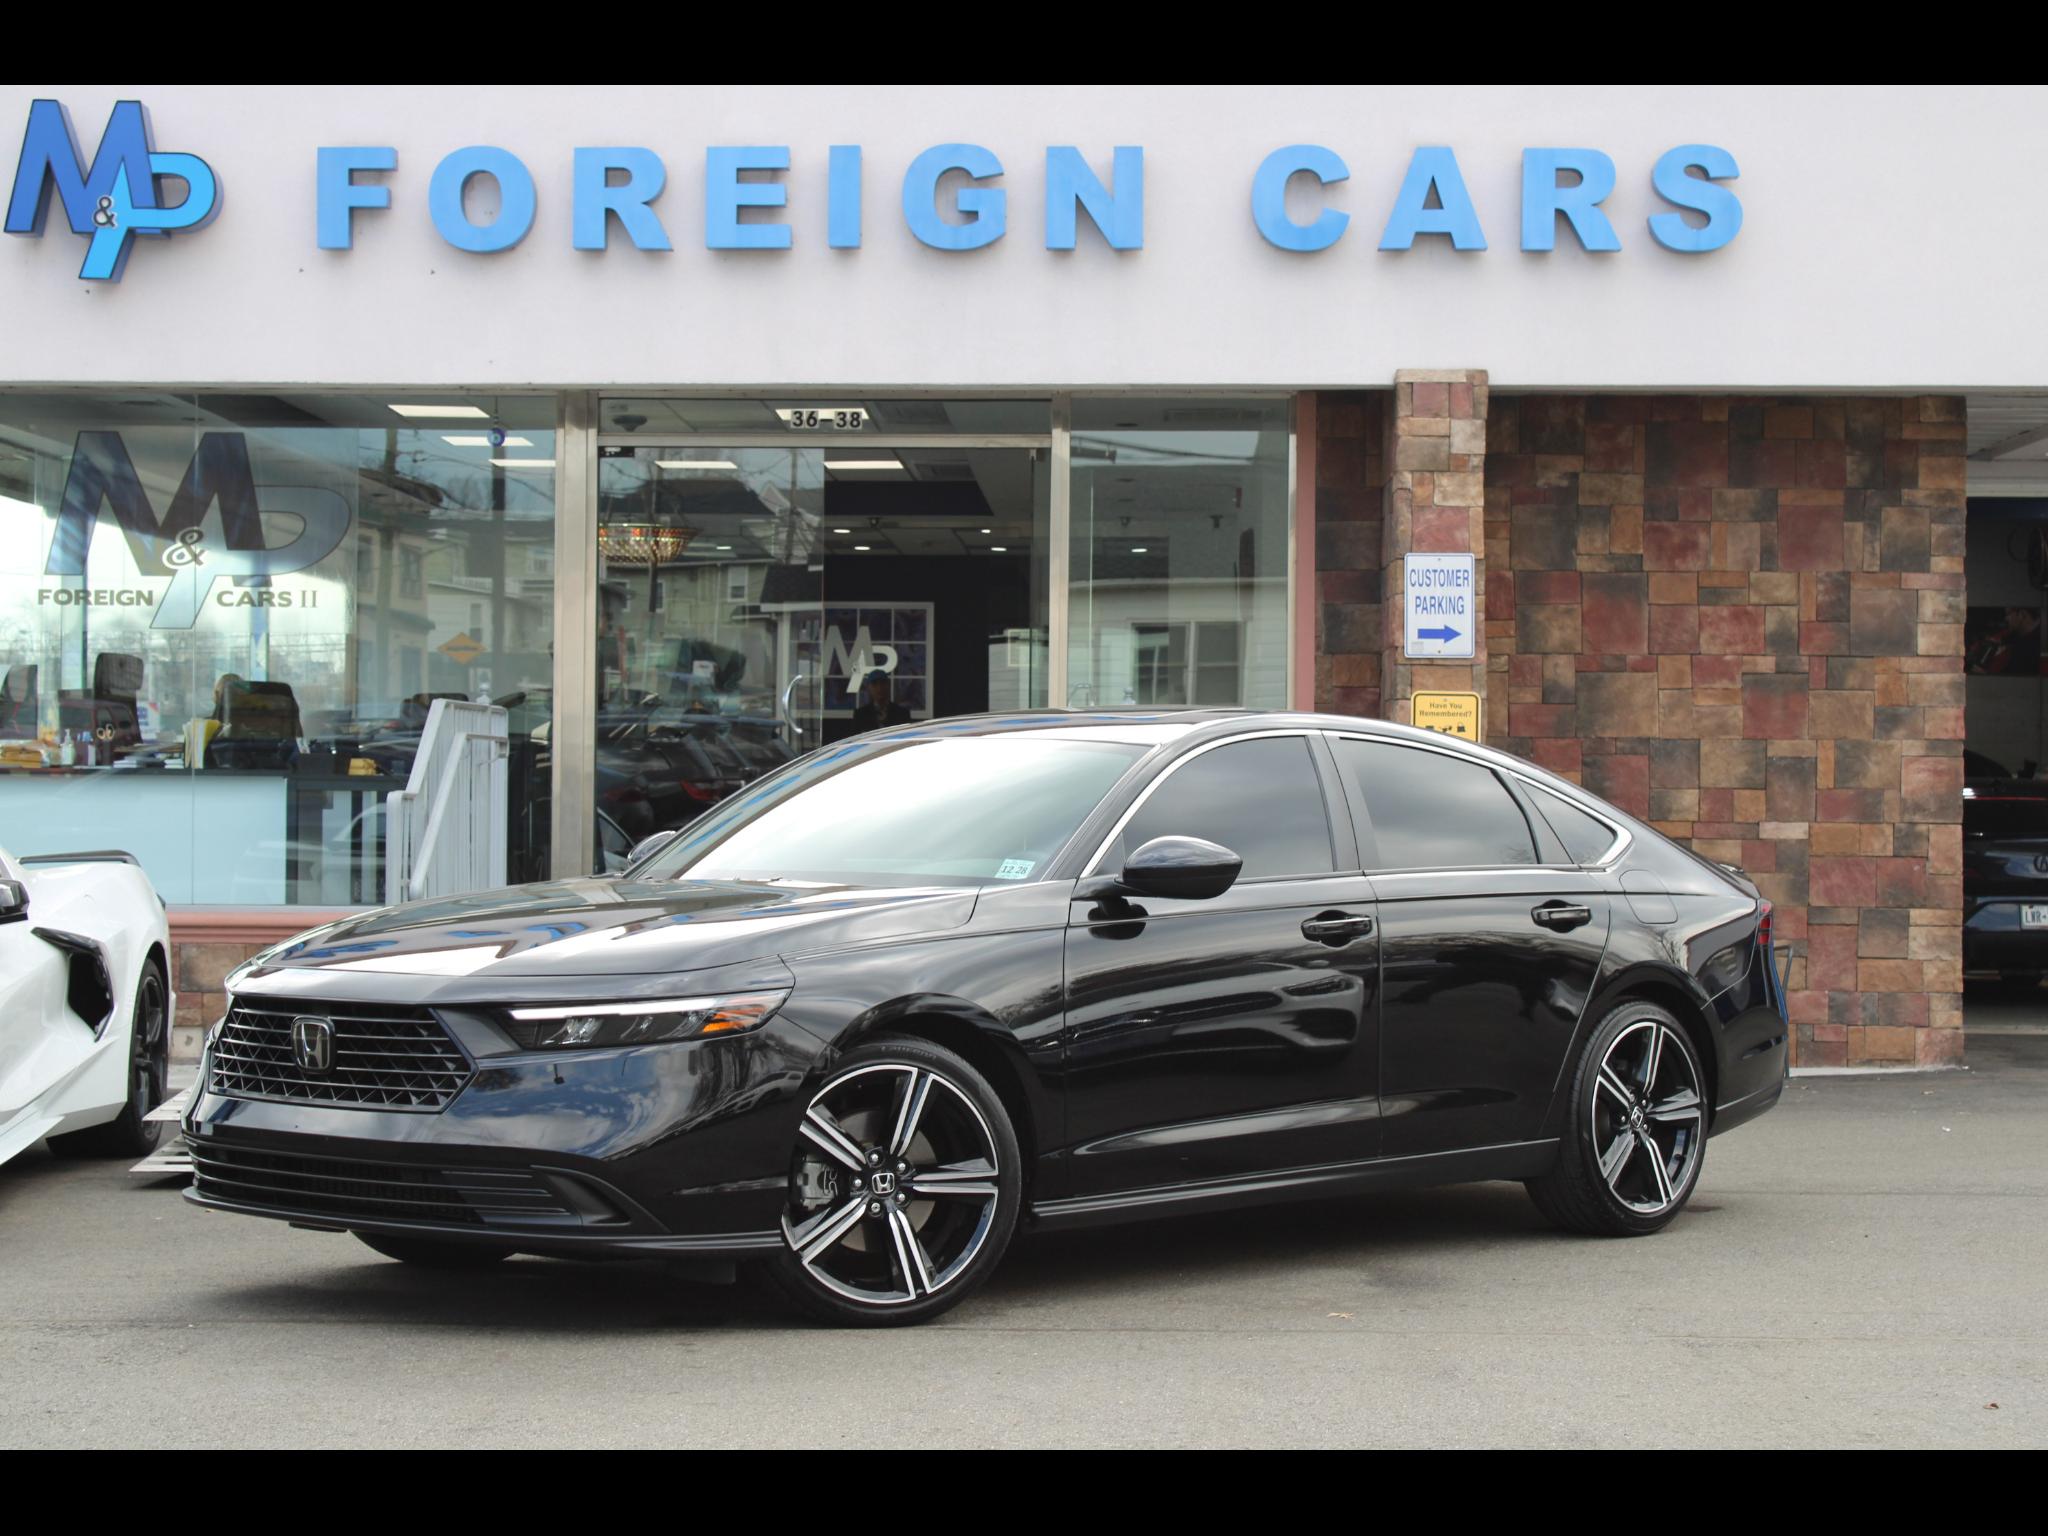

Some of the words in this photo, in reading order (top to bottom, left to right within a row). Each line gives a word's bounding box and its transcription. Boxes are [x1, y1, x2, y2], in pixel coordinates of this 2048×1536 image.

[316, 143, 1147, 253] FOREIGN
[1251, 143, 1745, 253] CARS
[792, 410, 861, 428] 36-38
[1409, 568, 1470, 588] CUSTOMER
[37, 588, 154, 607] FOREIGN
[216, 589, 293, 608] CARS
[1415, 595, 1465, 615] PARKING
[1419, 710, 1472, 718] Remembered?
